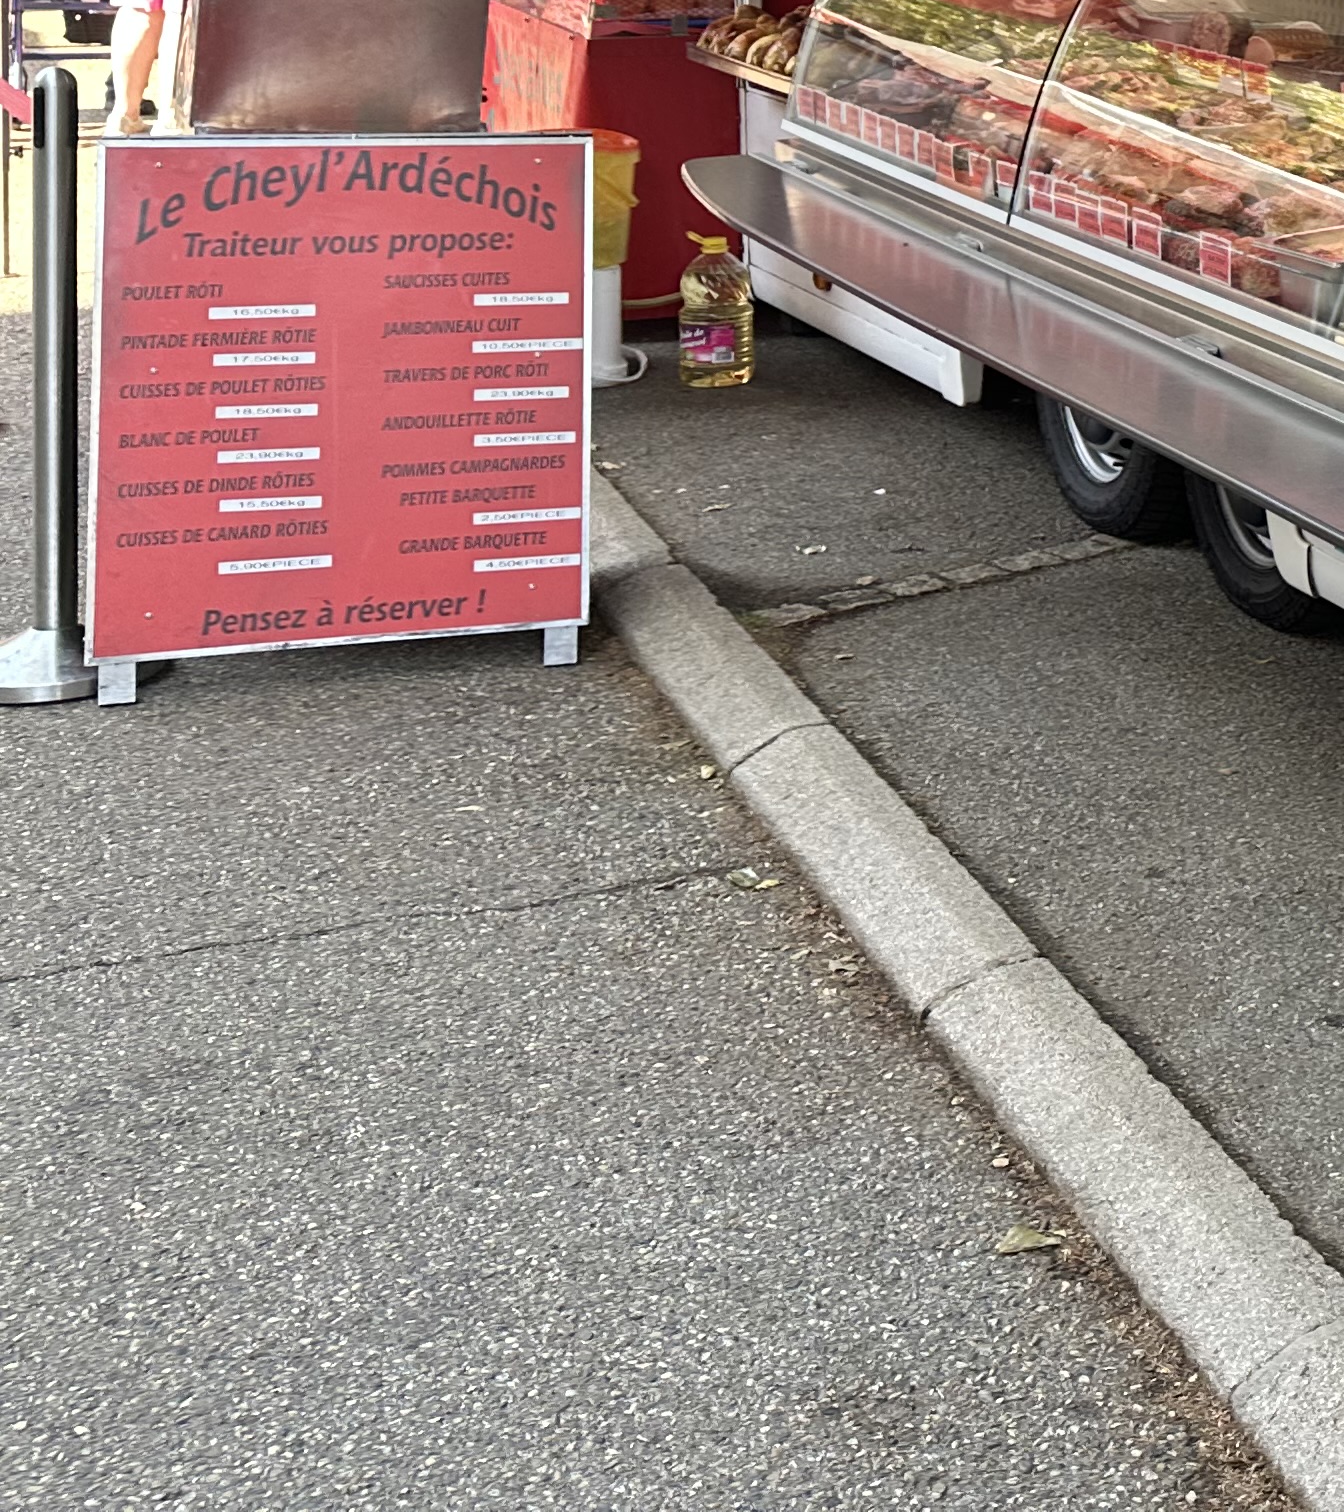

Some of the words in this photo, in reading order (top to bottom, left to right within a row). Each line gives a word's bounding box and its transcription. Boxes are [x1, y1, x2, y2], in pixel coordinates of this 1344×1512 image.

[135, 192, 185, 245] Le
[202, 148, 557, 231] Cheyl'Ardéchois
[183, 231, 302, 257] Traiteur
[312, 234, 379, 255] vous
[388, 231, 514, 259] propose:
[121, 284, 183, 301] POULET
[186, 281, 223, 299] RÔTI
[384, 274, 457, 289] SAUCISSES
[462, 272, 510, 287] CUITES
[120, 334, 188, 350] PINTADE
[191, 329, 267, 347] FERMIÈRE
[271, 328, 317, 346] RÔTIE
[382, 320, 483, 337] JAMBONNEAU
[488, 318, 522, 333] CUIT
[383, 368, 446, 383] TRAVERS
[451, 366, 469, 381] DE
[474, 365, 512, 379] PORC
[515, 360, 549, 377] RÔTI
[119, 382, 180, 399] CUISSES
[186, 381, 206, 397] DE
[209, 378, 269, 395] POULET
[274, 374, 326, 392] RÔTIES
[381, 412, 491, 430] ANDOUILLETTE
[495, 408, 537, 425] RÔTIE
[118, 432, 172, 448] BLANC
[175, 431, 196, 446] DE
[200, 427, 260, 444] POULET
[381, 462, 446, 478] POMMES
[450, 455, 566, 474] CAMPAGNARDES
[117, 480, 179, 498] CUISSES
[183, 479, 203, 495] DE
[208, 476, 257, 494] DINDE
[262, 471, 316, 489] RÔTIES
[400, 489, 447, 506] PETITE
[451, 485, 537, 503] BARQUETTE
[116, 530, 177, 548] CUISSES
[182, 529, 203, 544] DE
[207, 524, 271, 542] CANARD
[276, 519, 328, 537] RÔTIES
[399, 537, 460, 554] GRANDE
[463, 531, 548, 550] BARQUETTE
[202, 608, 307, 636] Pensez
[316, 600, 333, 626] à
[344, 596, 468, 624] réserver
[477, 588, 486, 613] !
